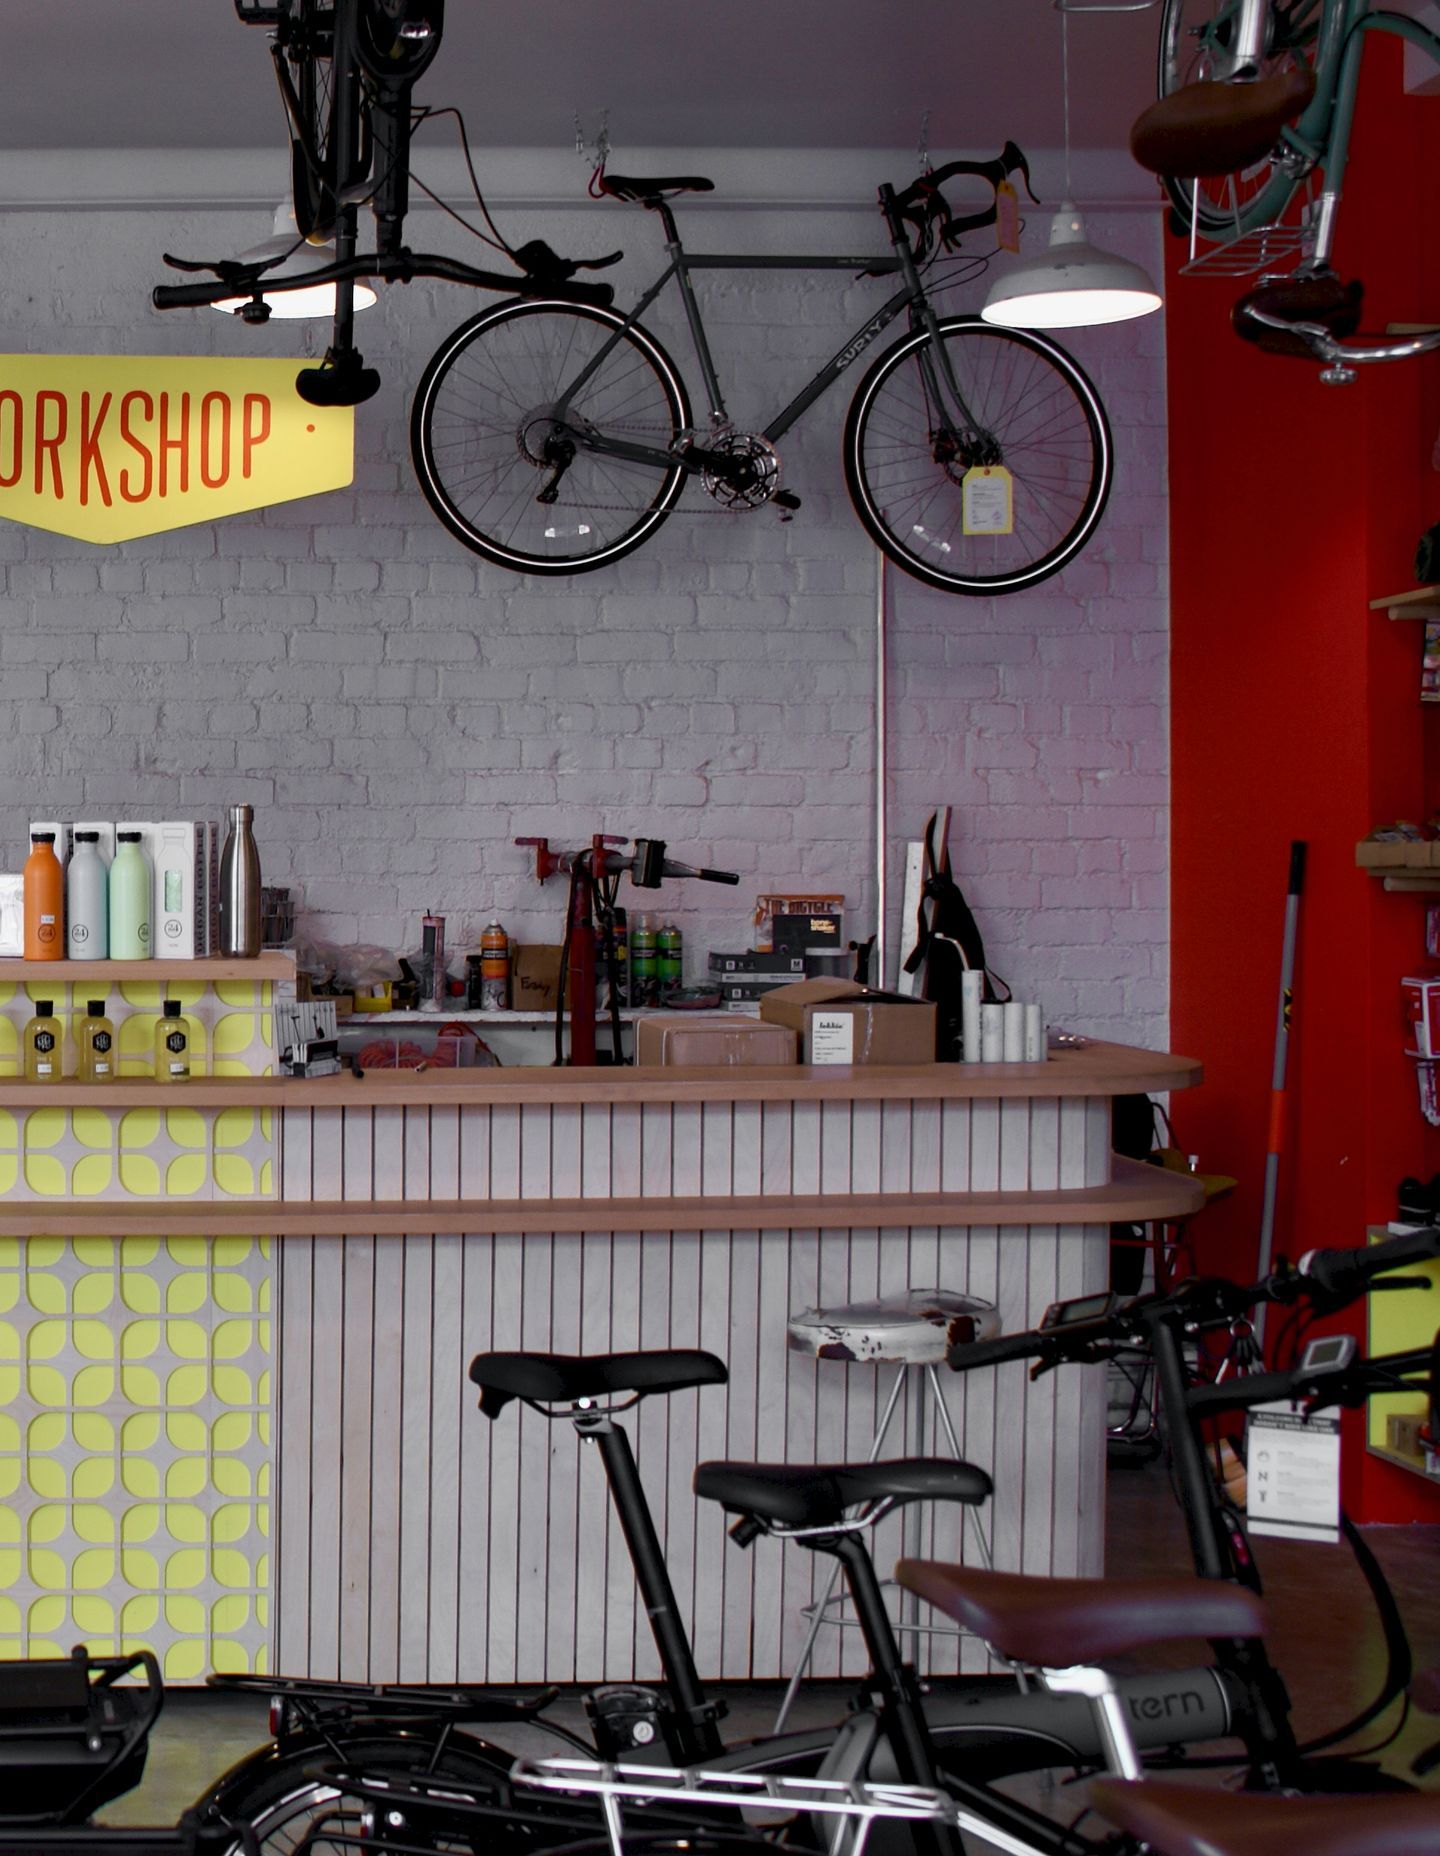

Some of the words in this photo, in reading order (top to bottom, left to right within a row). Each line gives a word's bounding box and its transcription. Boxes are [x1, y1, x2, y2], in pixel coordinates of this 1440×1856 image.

[835, 319, 883, 369] SURLY
[196, 827, 205, 890] BOTTLE
[196, 896, 206, 954] URBAN
[1128, 1689, 1206, 1720] tern
